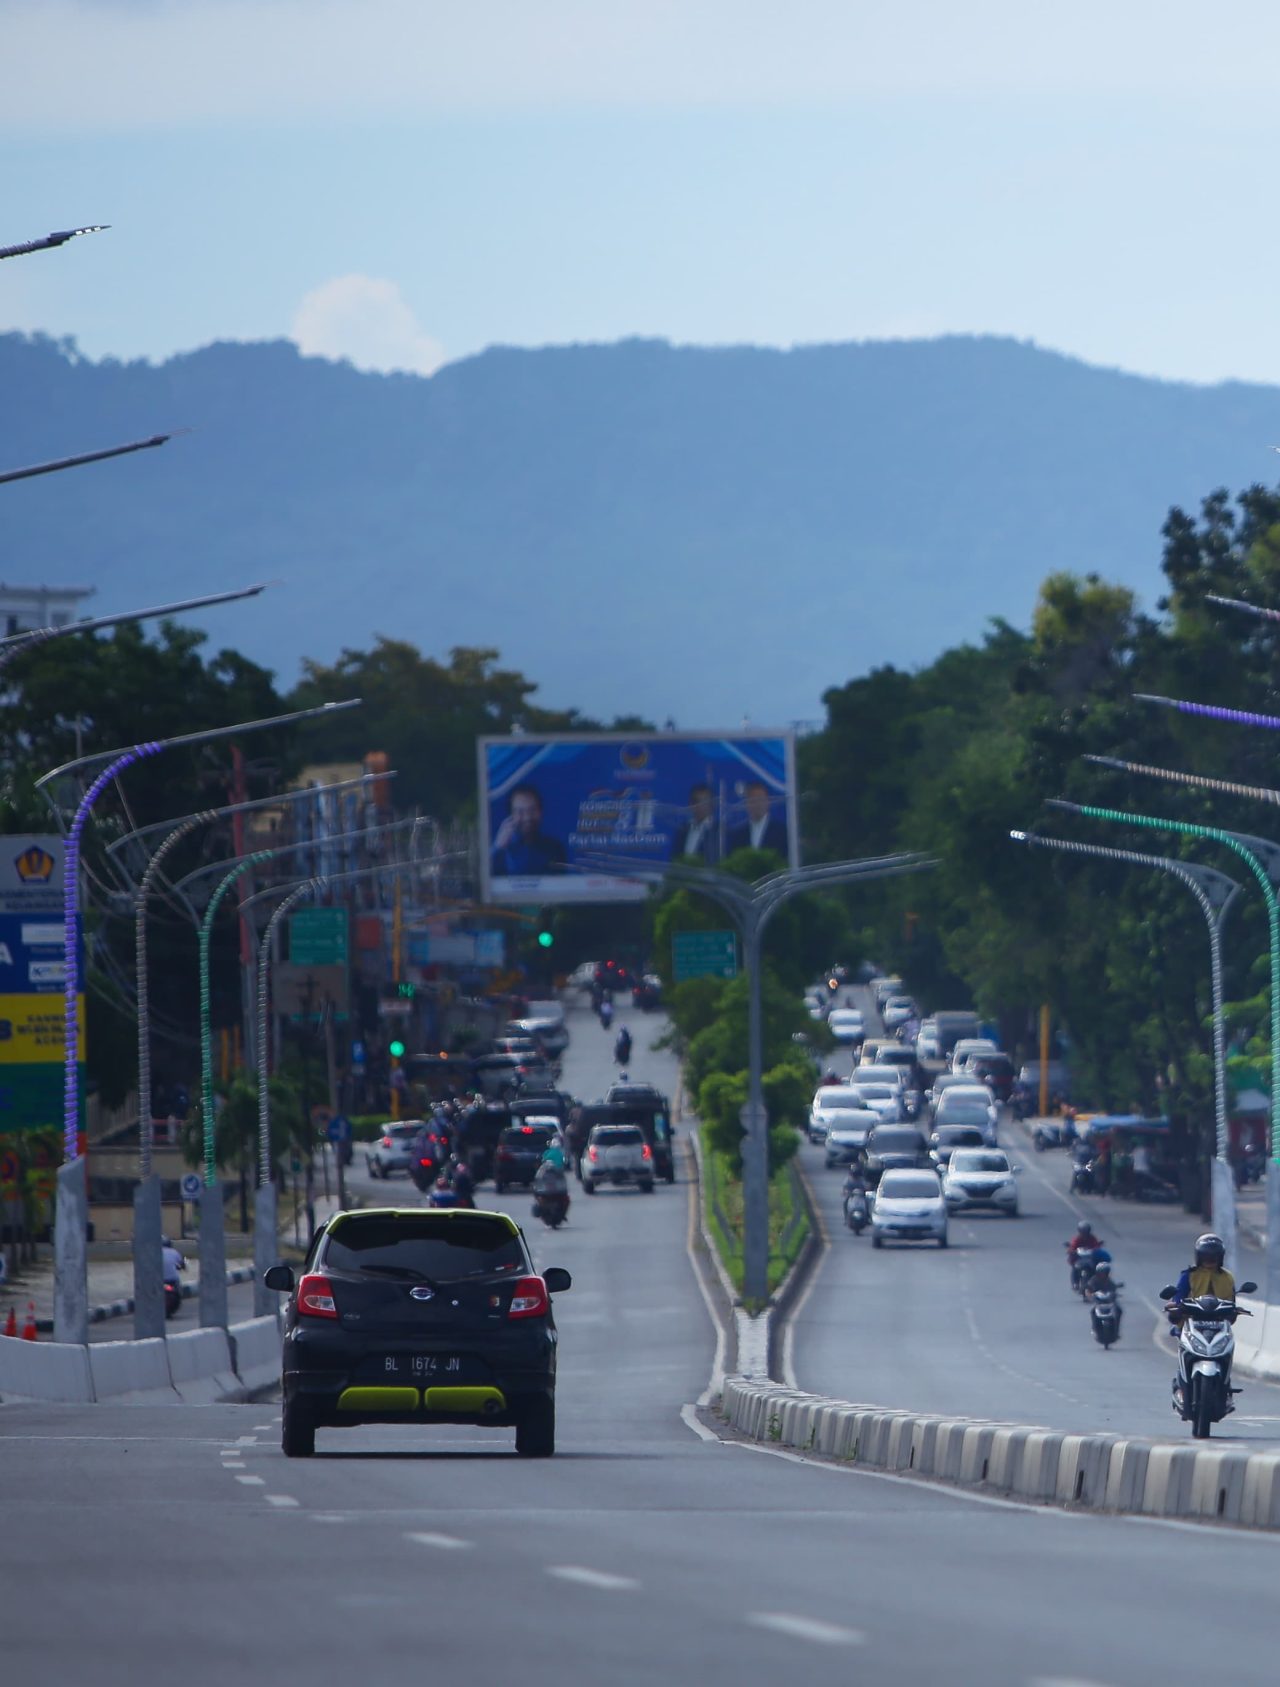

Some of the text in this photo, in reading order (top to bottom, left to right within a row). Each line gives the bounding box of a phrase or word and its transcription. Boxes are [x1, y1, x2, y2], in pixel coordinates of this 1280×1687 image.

[385, 1356, 460, 1371] BL 1674 JN
